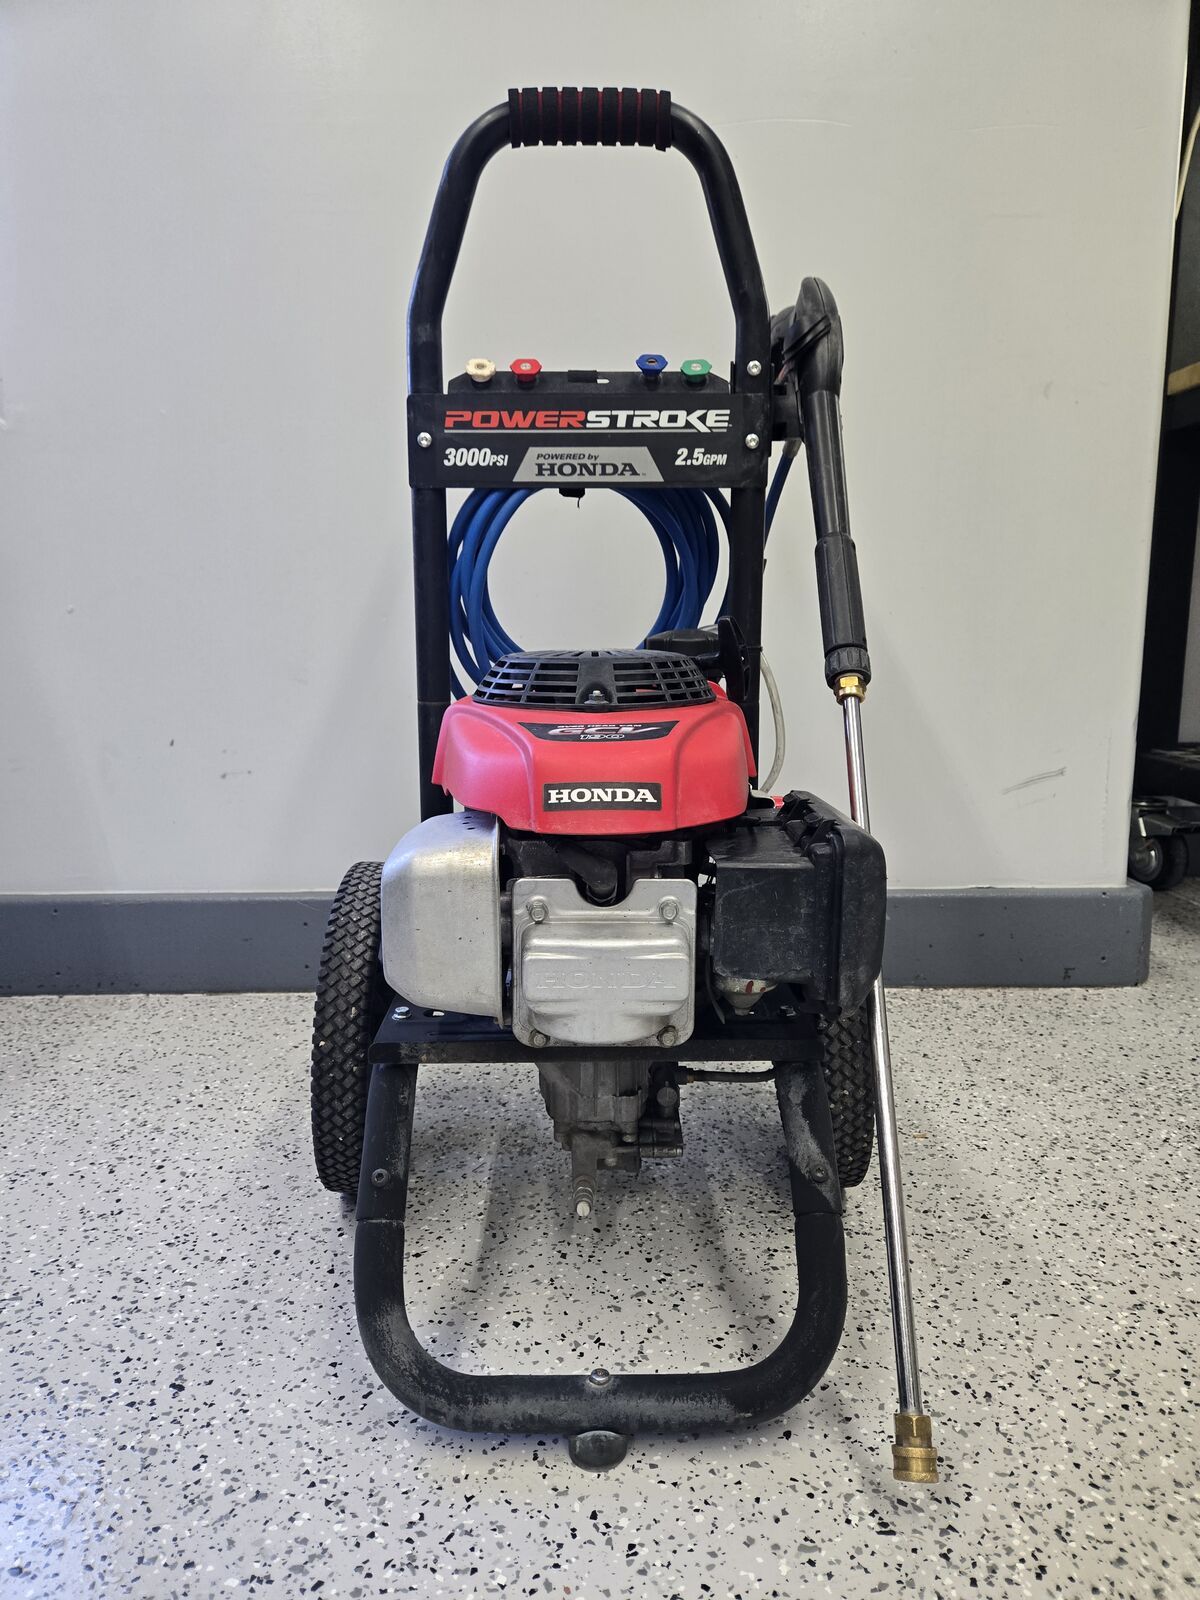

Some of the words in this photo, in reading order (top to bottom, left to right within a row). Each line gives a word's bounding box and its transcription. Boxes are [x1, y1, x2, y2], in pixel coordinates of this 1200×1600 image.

[444, 409, 731, 433] POWERSTROKE
[443, 447, 509, 466] 3000PSI
[587, 453, 600, 461] by
[674, 448, 728, 466] 2.5GPM
[535, 463, 640, 477] HONDA
[548, 726, 661, 734] GCV
[547, 788, 657, 804] HONDA
[535, 971, 677, 989] HONDA
